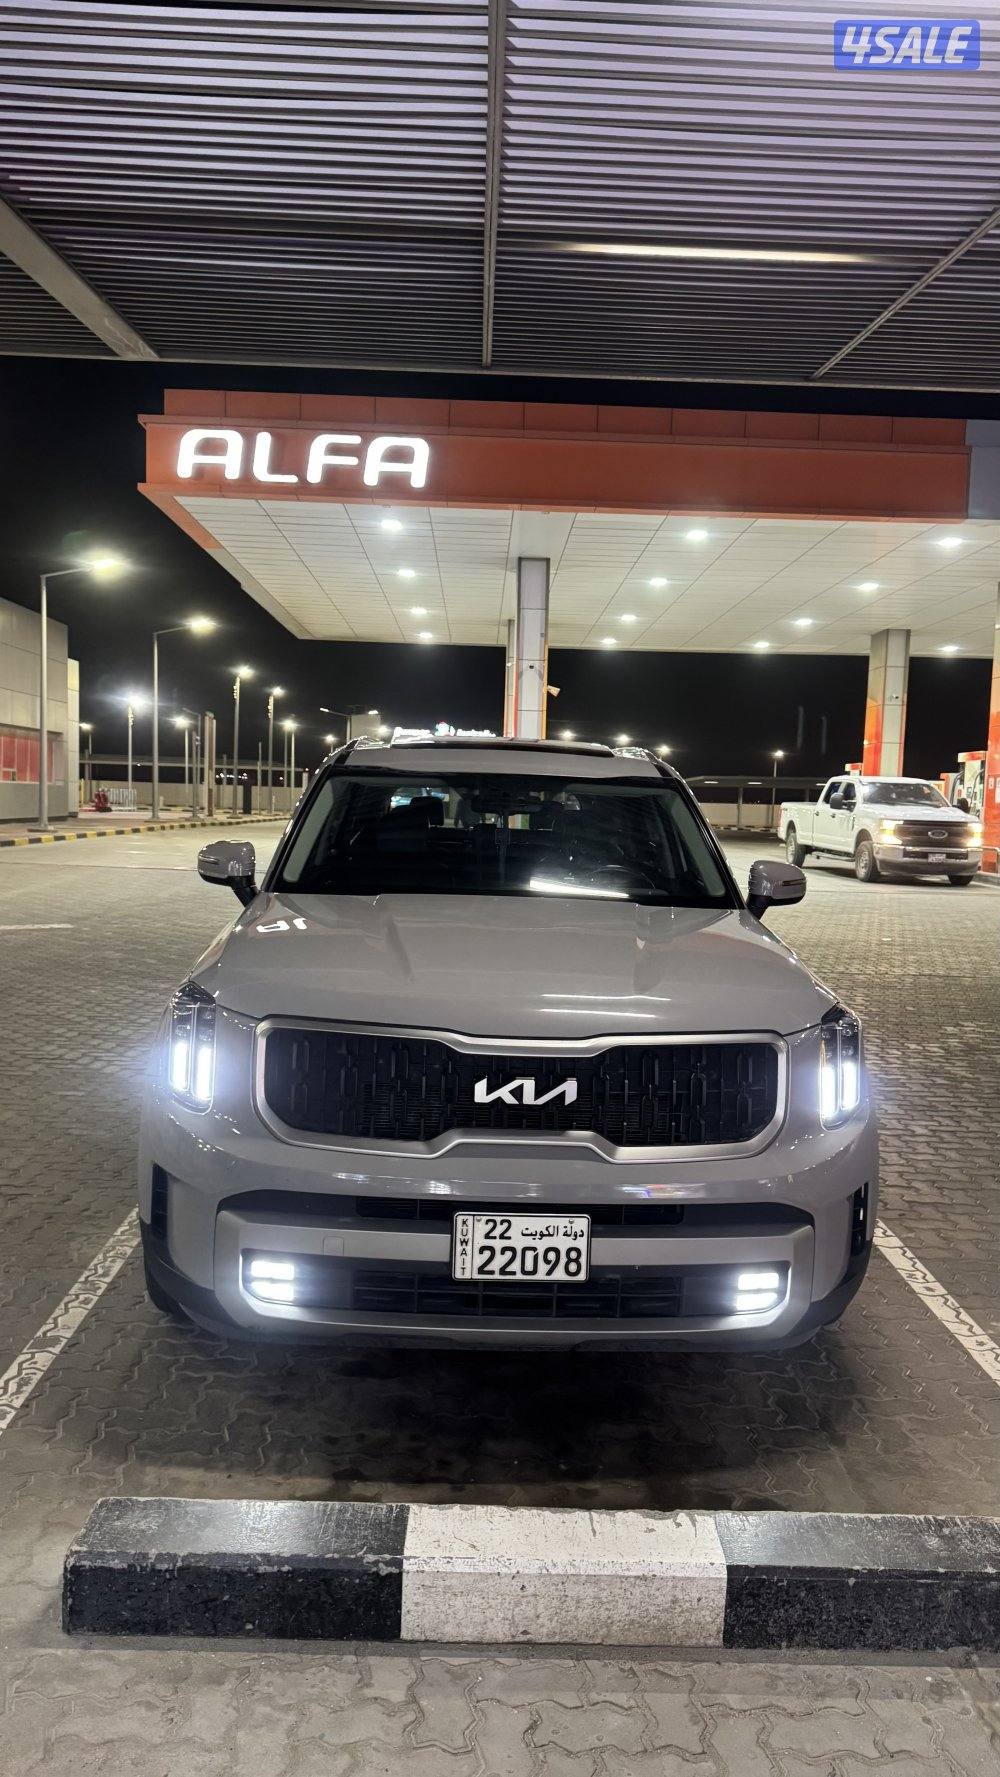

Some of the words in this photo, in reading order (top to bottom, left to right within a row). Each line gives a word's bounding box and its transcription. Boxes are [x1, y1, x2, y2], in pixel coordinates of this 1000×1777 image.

[176, 428, 430, 488] ALFA
[474, 1075, 578, 1106] KIA
[484, 1218, 512, 1240] 22
[520, 1225, 559, 1240] الكويت
[562, 1222, 585, 1240] دولة
[459, 1218, 469, 1276] KUWAIT
[477, 1245, 583, 1277] 22098
